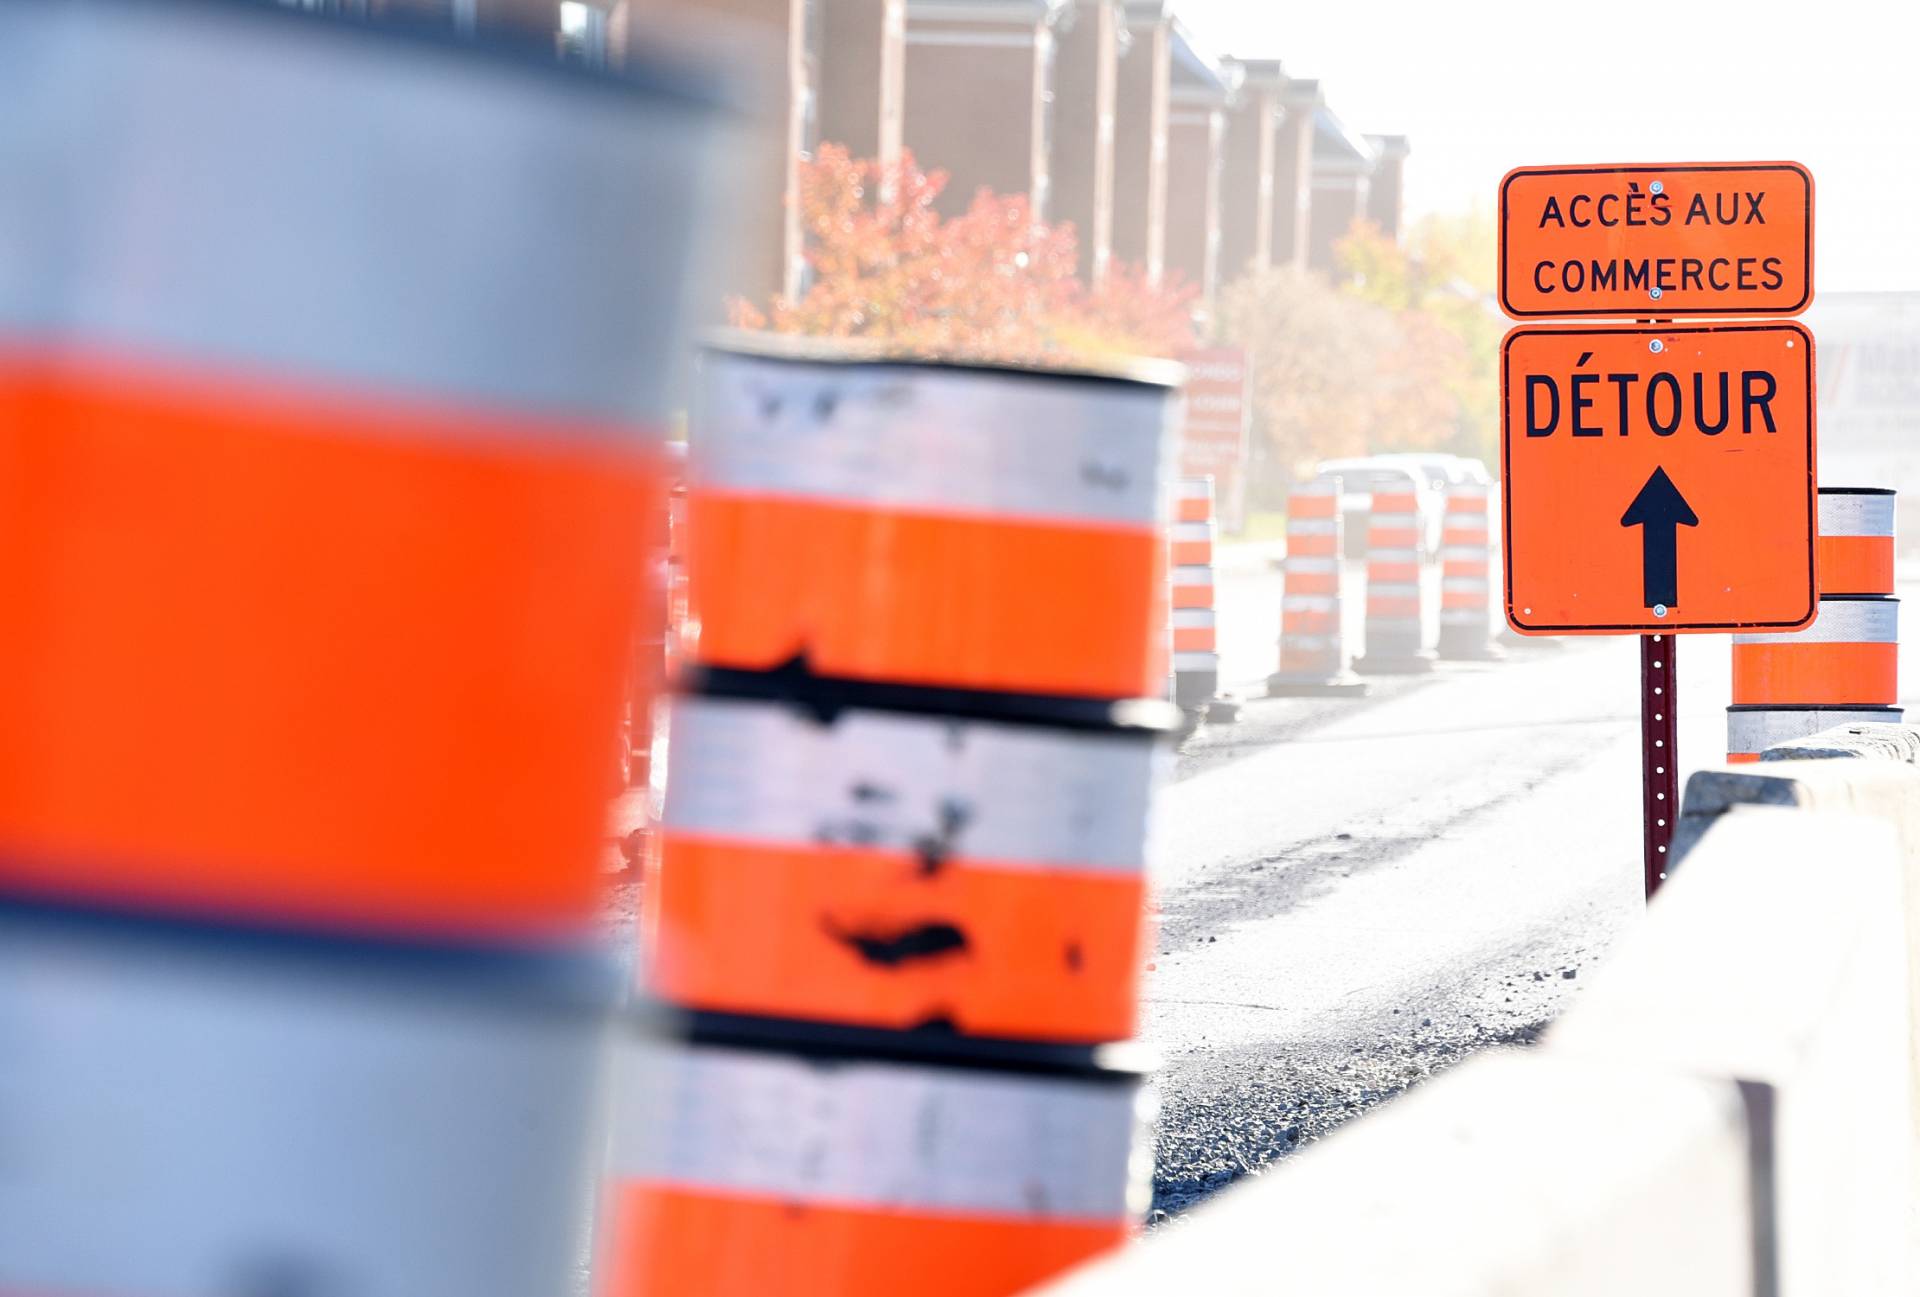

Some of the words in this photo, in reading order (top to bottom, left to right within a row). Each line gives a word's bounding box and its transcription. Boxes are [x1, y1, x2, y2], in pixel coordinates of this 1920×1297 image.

[1539, 182, 1672, 228] ACCÈS
[1684, 191, 1766, 225] AUX
[1533, 257, 1784, 294] COMMERCES
[1525, 352, 1777, 437] DÉTOUR
